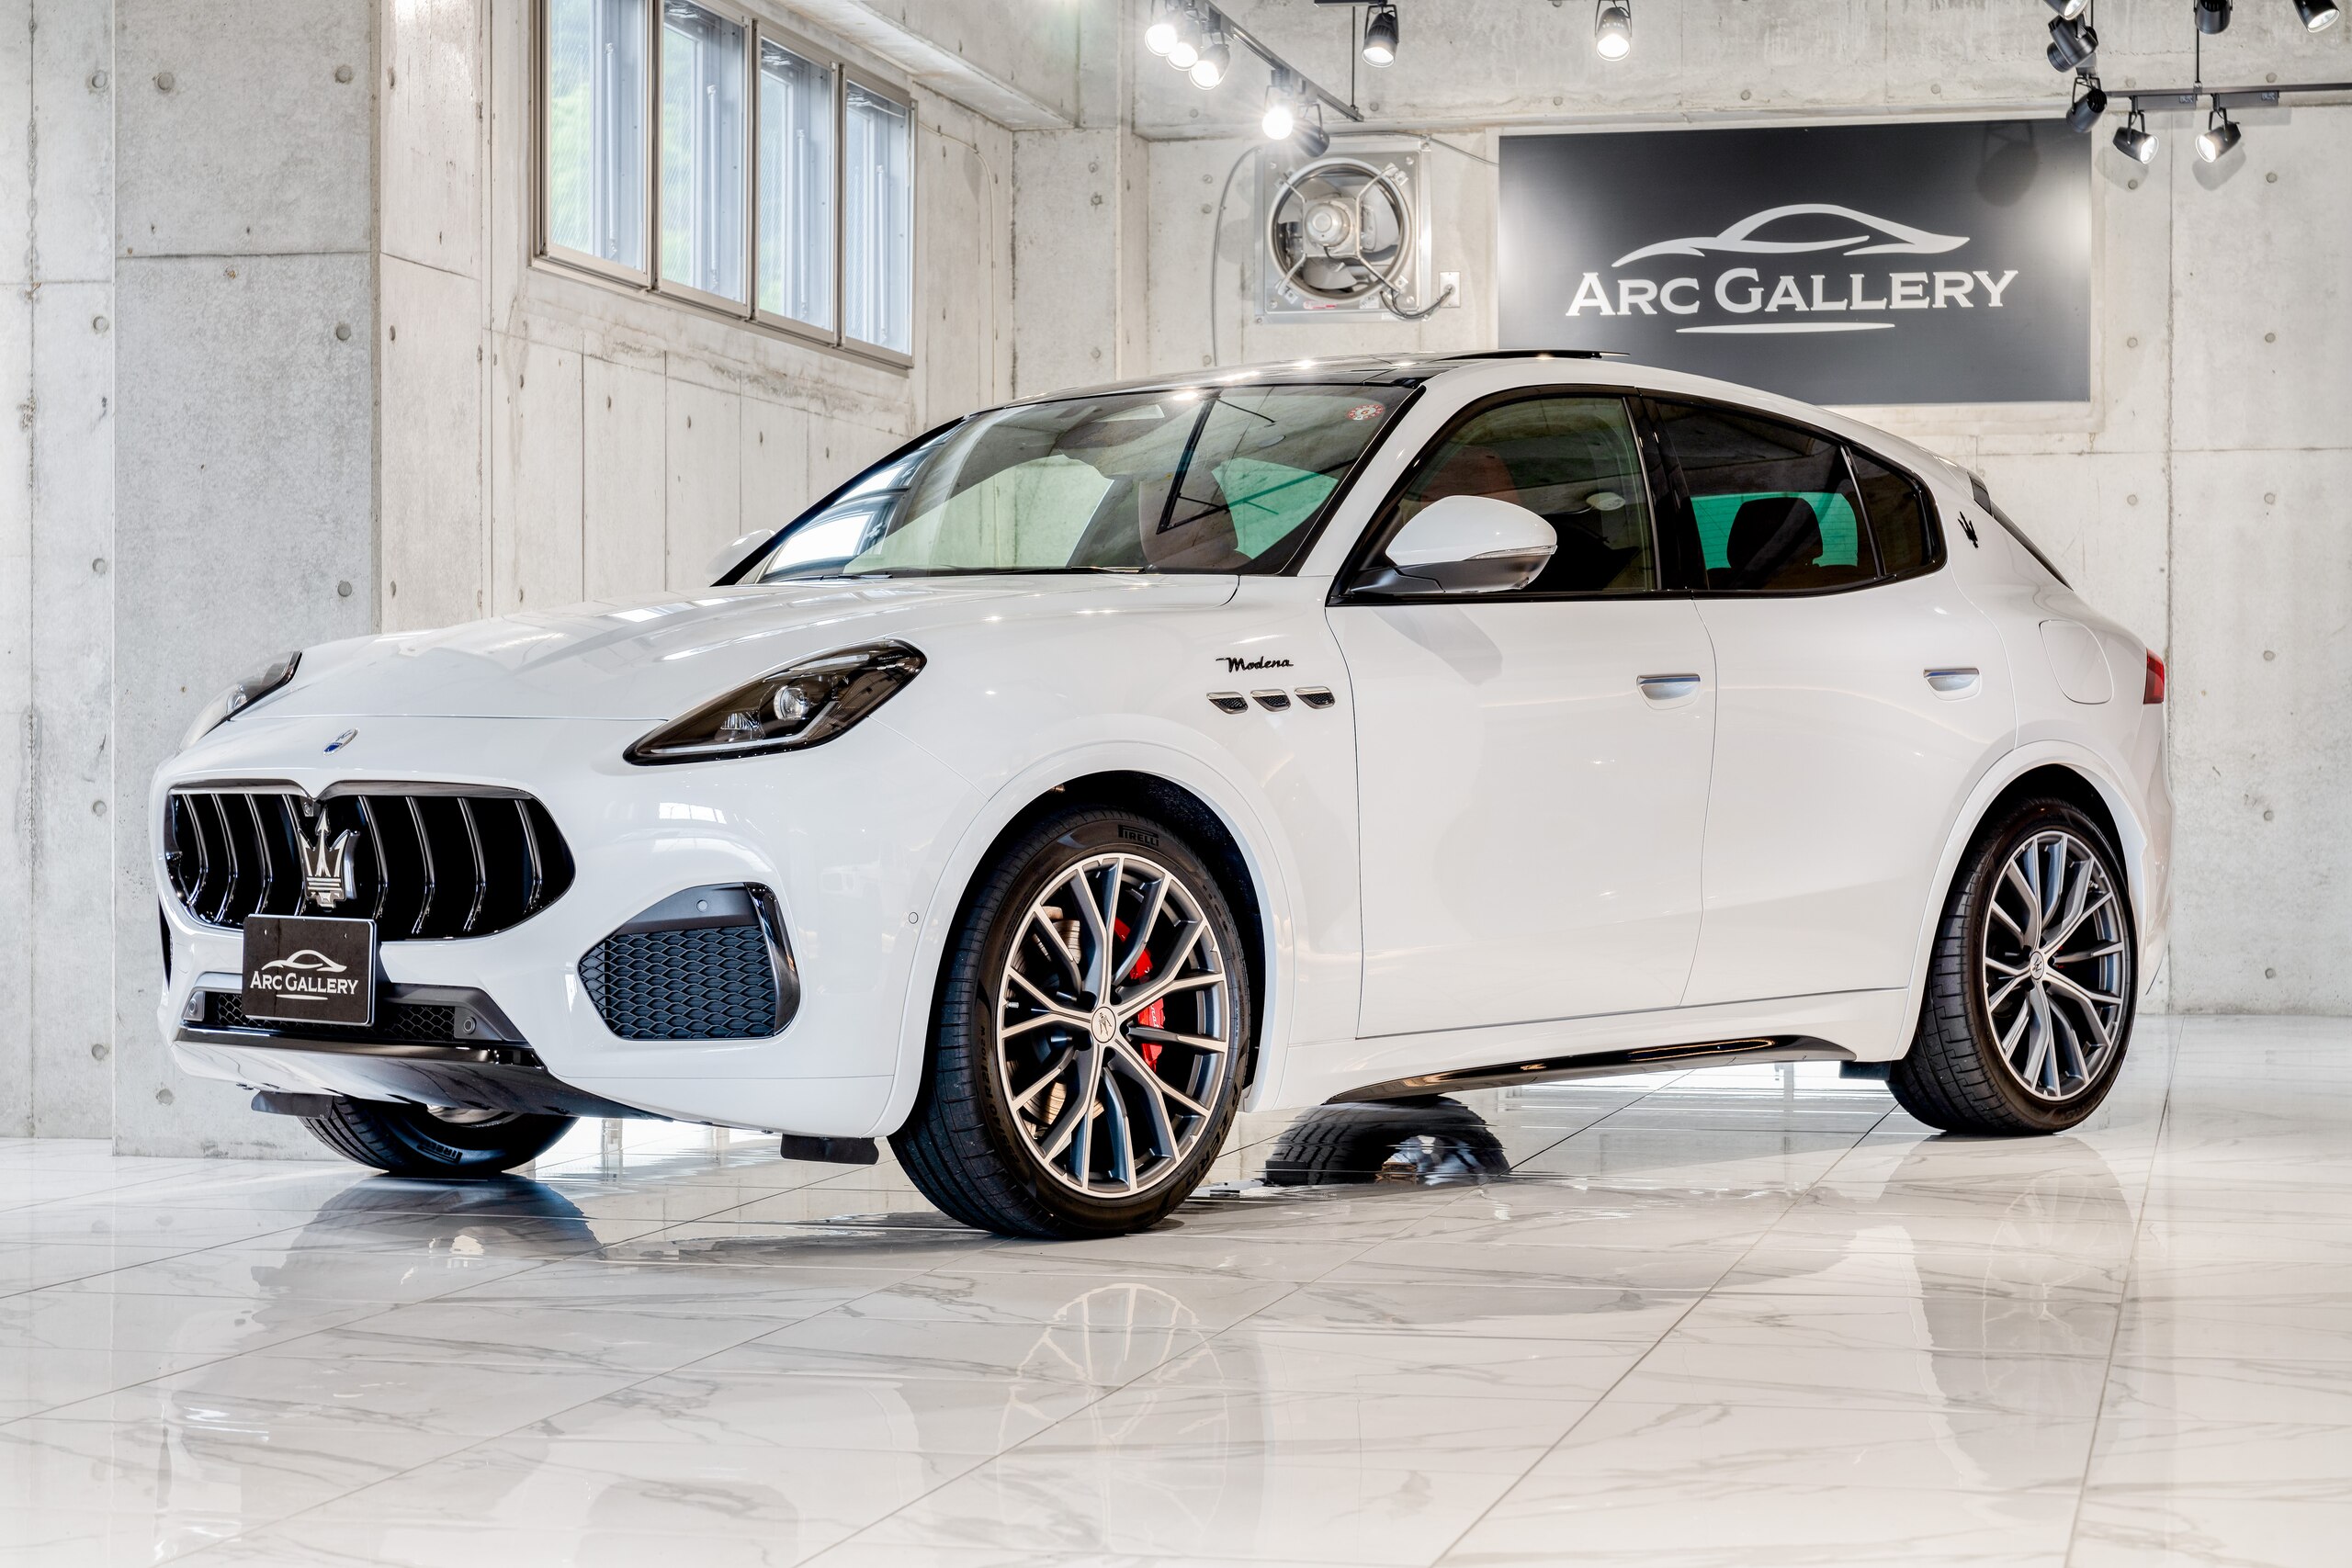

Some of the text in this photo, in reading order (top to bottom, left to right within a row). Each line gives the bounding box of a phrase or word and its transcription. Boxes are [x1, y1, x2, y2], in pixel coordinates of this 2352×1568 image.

[1714, 266, 2018, 313] GALLERY
[1216, 656, 1295, 673] Modena
[1117, 824, 1159, 847] PIRELLI
[285, 972, 359, 995] GALLERY
[416, 1140, 463, 1164] PIREL
[1186, 1110, 1230, 1189] ZERO
